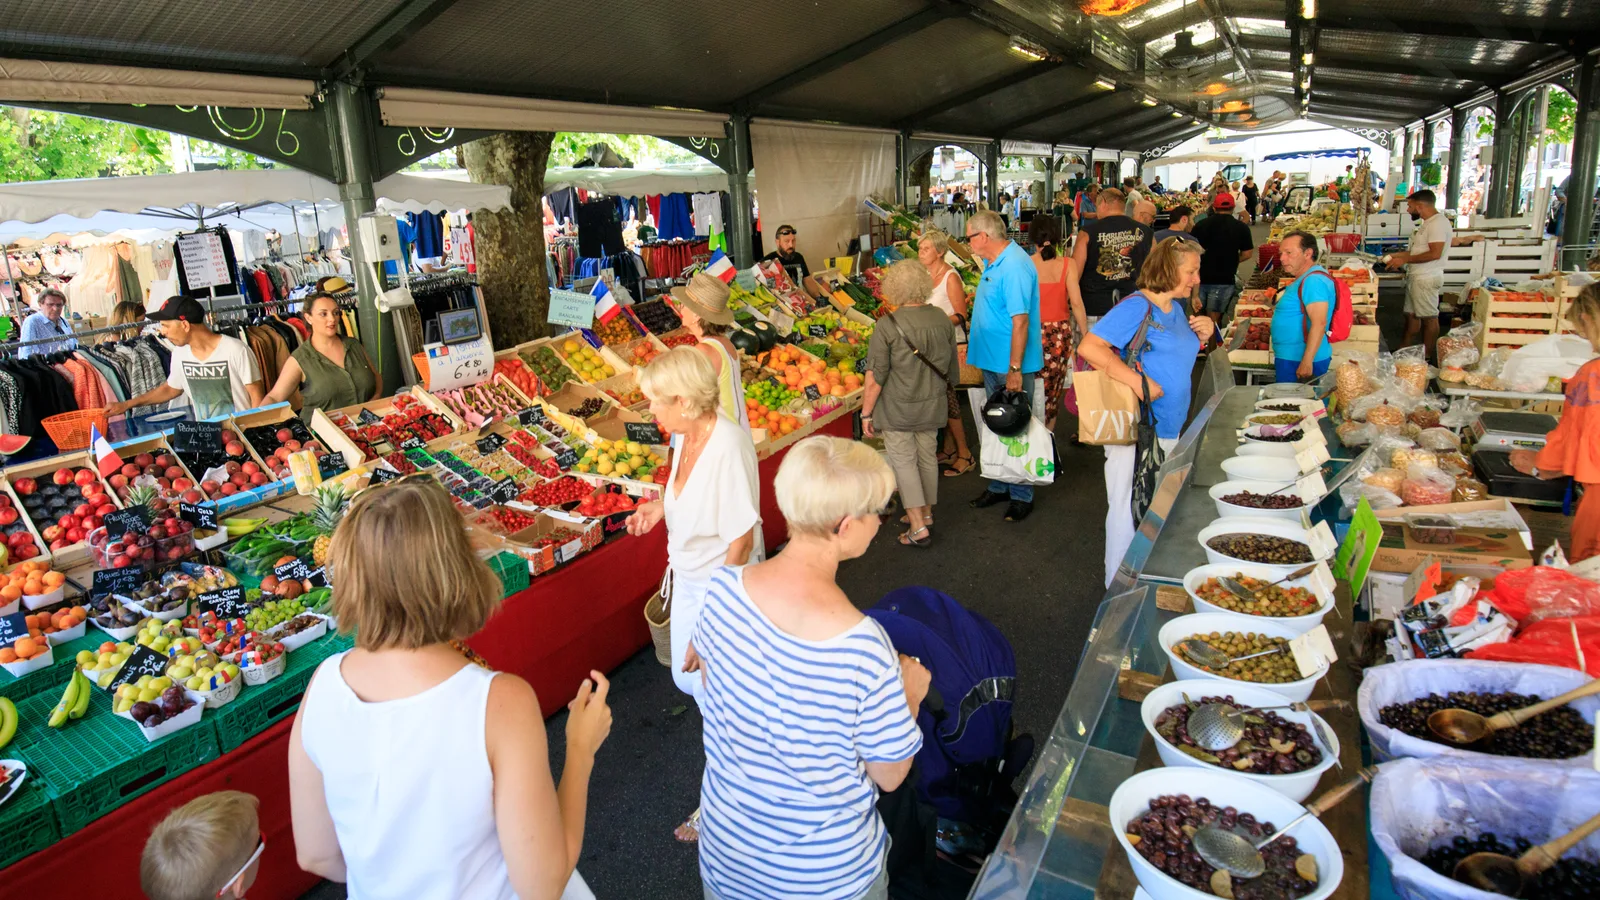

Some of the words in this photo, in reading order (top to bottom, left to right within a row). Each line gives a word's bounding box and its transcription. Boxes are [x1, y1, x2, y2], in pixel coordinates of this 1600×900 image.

[562, 304, 580, 312] CARTE
[558, 312, 584, 320] BANCAIRE
[1090, 409, 1140, 441] ZAR
